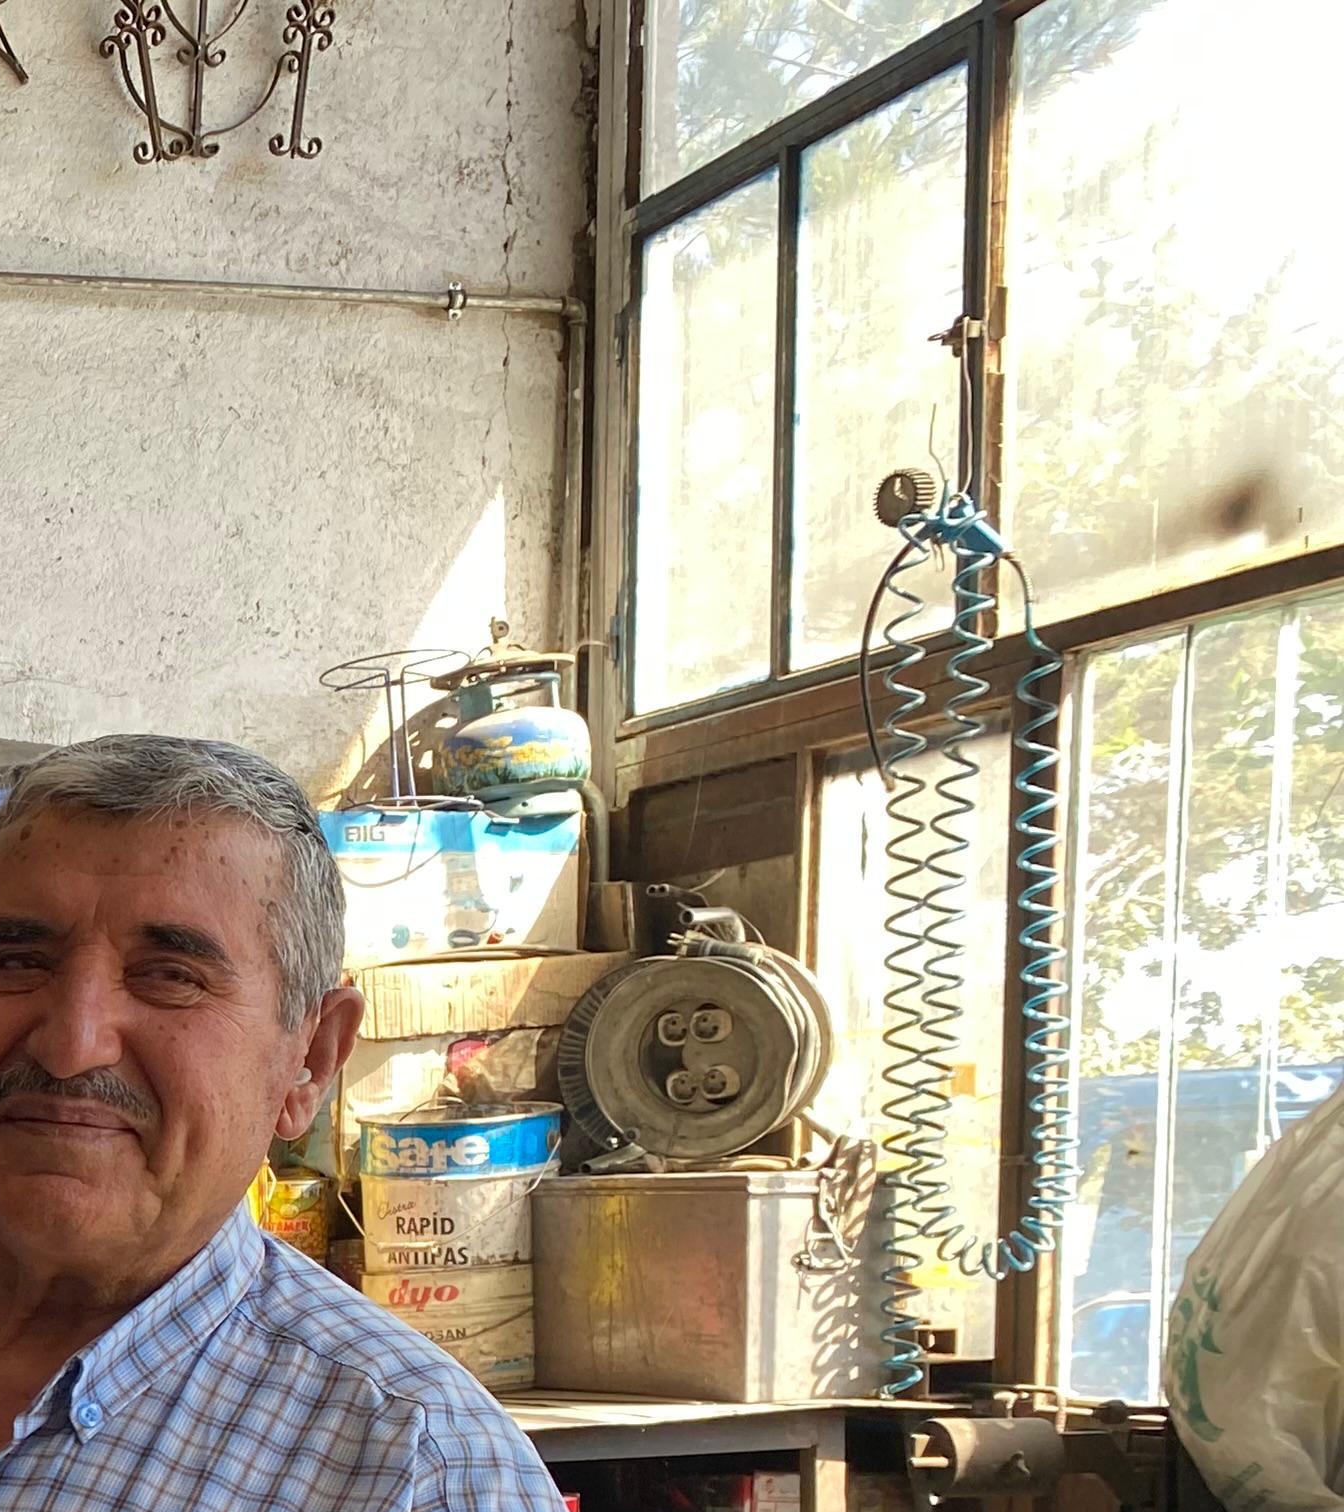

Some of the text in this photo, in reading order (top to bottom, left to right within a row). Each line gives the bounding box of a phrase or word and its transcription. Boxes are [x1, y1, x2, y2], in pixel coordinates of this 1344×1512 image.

[396, 1212, 455, 1236] RAPİD
[389, 1279, 460, 1313] dyo
[418, 1327, 467, 1342] OSAN
